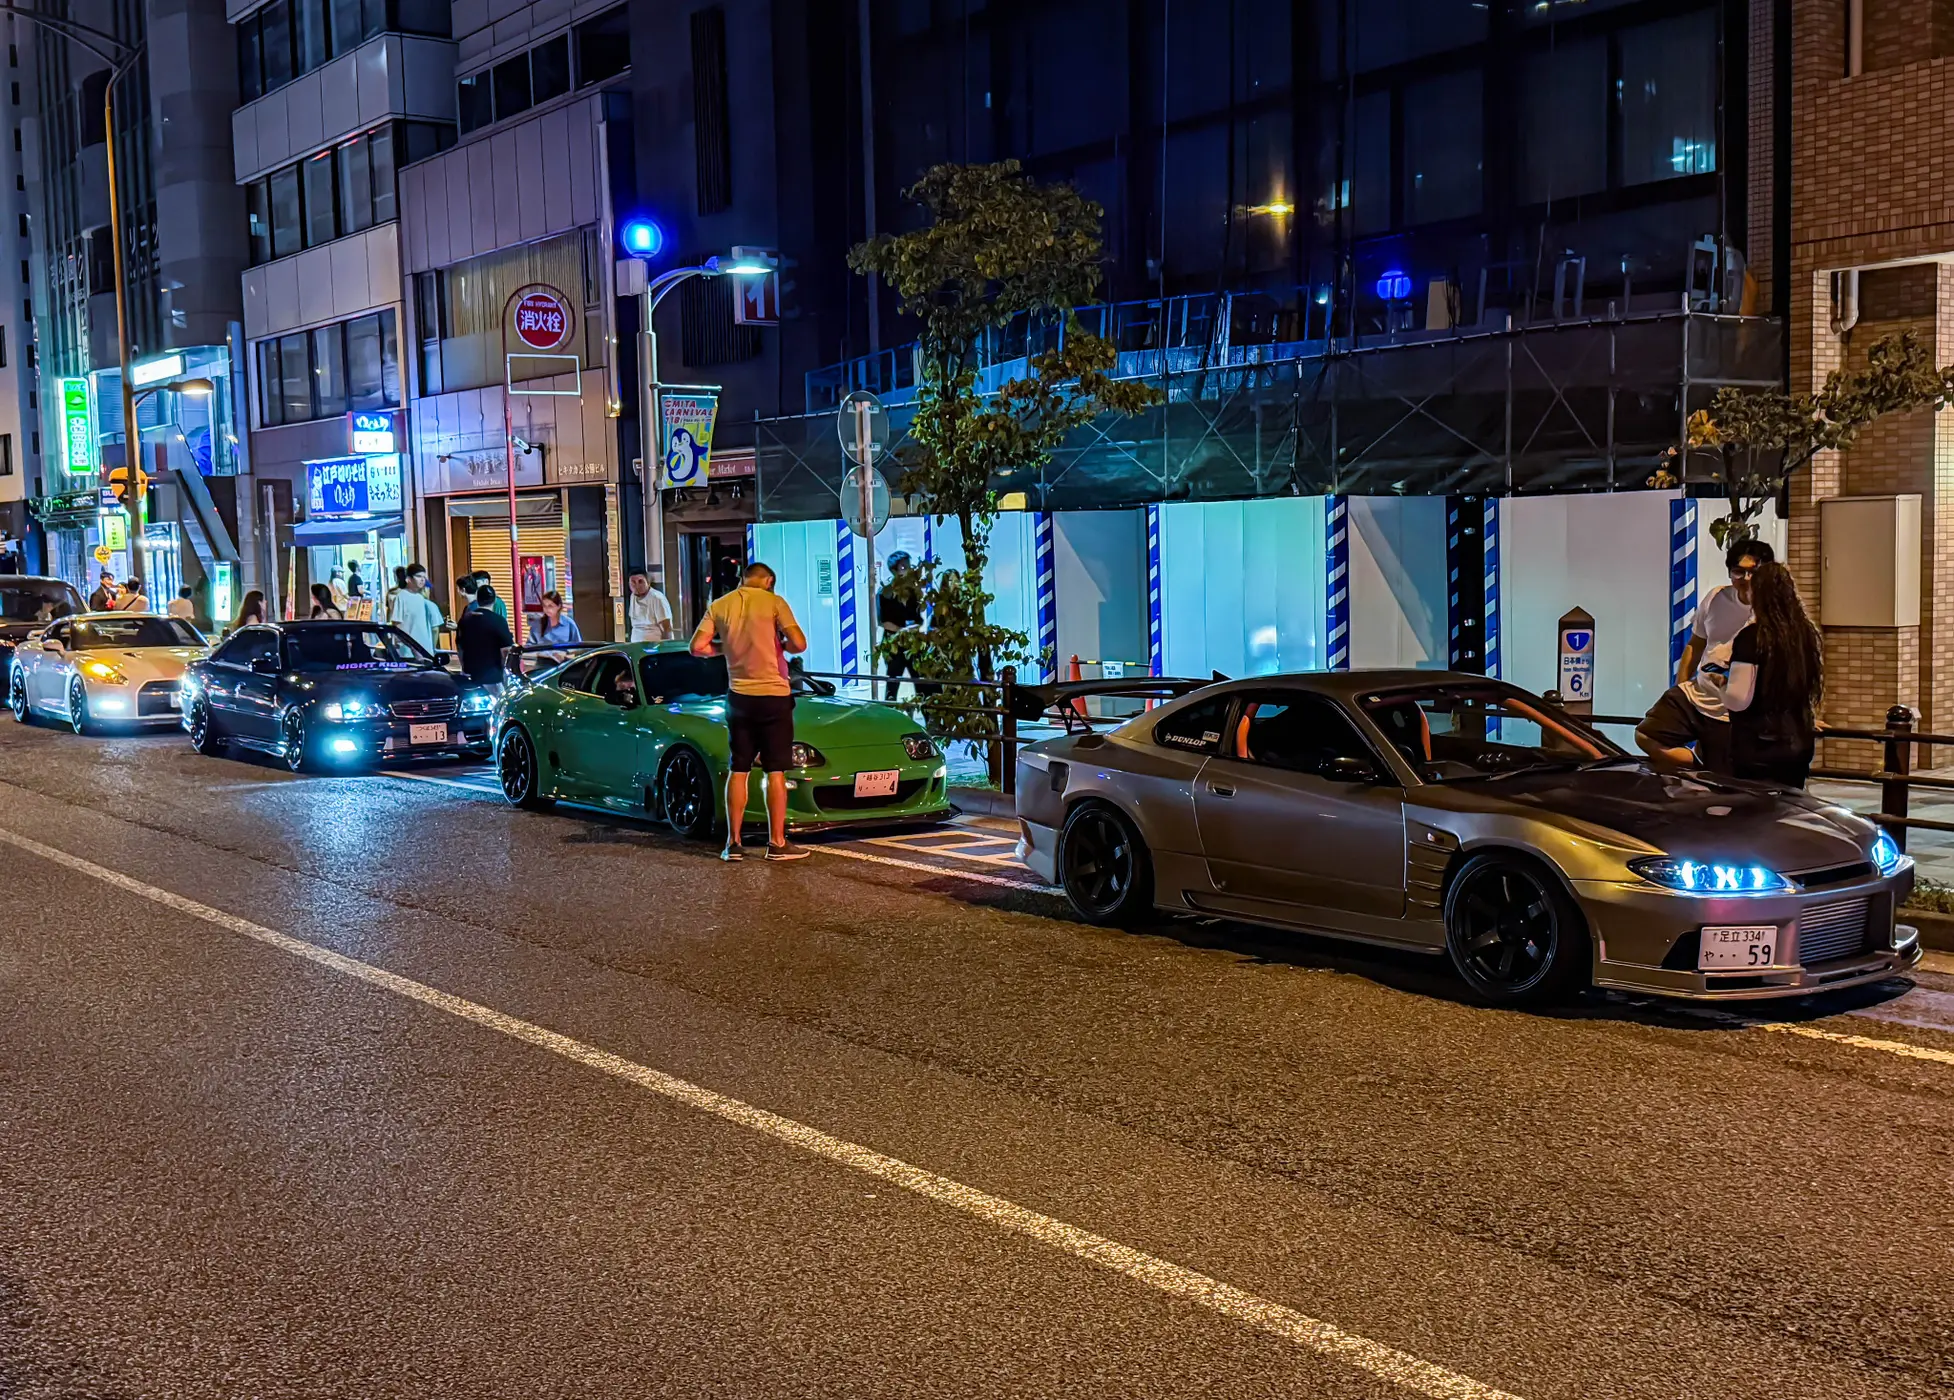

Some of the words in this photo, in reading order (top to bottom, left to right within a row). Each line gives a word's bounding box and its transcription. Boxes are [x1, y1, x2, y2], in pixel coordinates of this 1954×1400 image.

[520, 310, 562, 332] 消火栓
[664, 408, 713, 416] CARNIVAL
[1573, 634, 1580, 647] 1
[335, 662, 377, 670] NIGHT
[1570, 674, 1583, 692] 6
[435, 731, 445, 740] 13
[1171, 735, 1207, 746] DUNLOP
[889, 780, 896, 792] 4
[1719, 931, 1740, 942] 足立
[1703, 951, 1714, 961] や
[1748, 944, 1771, 965] 59
